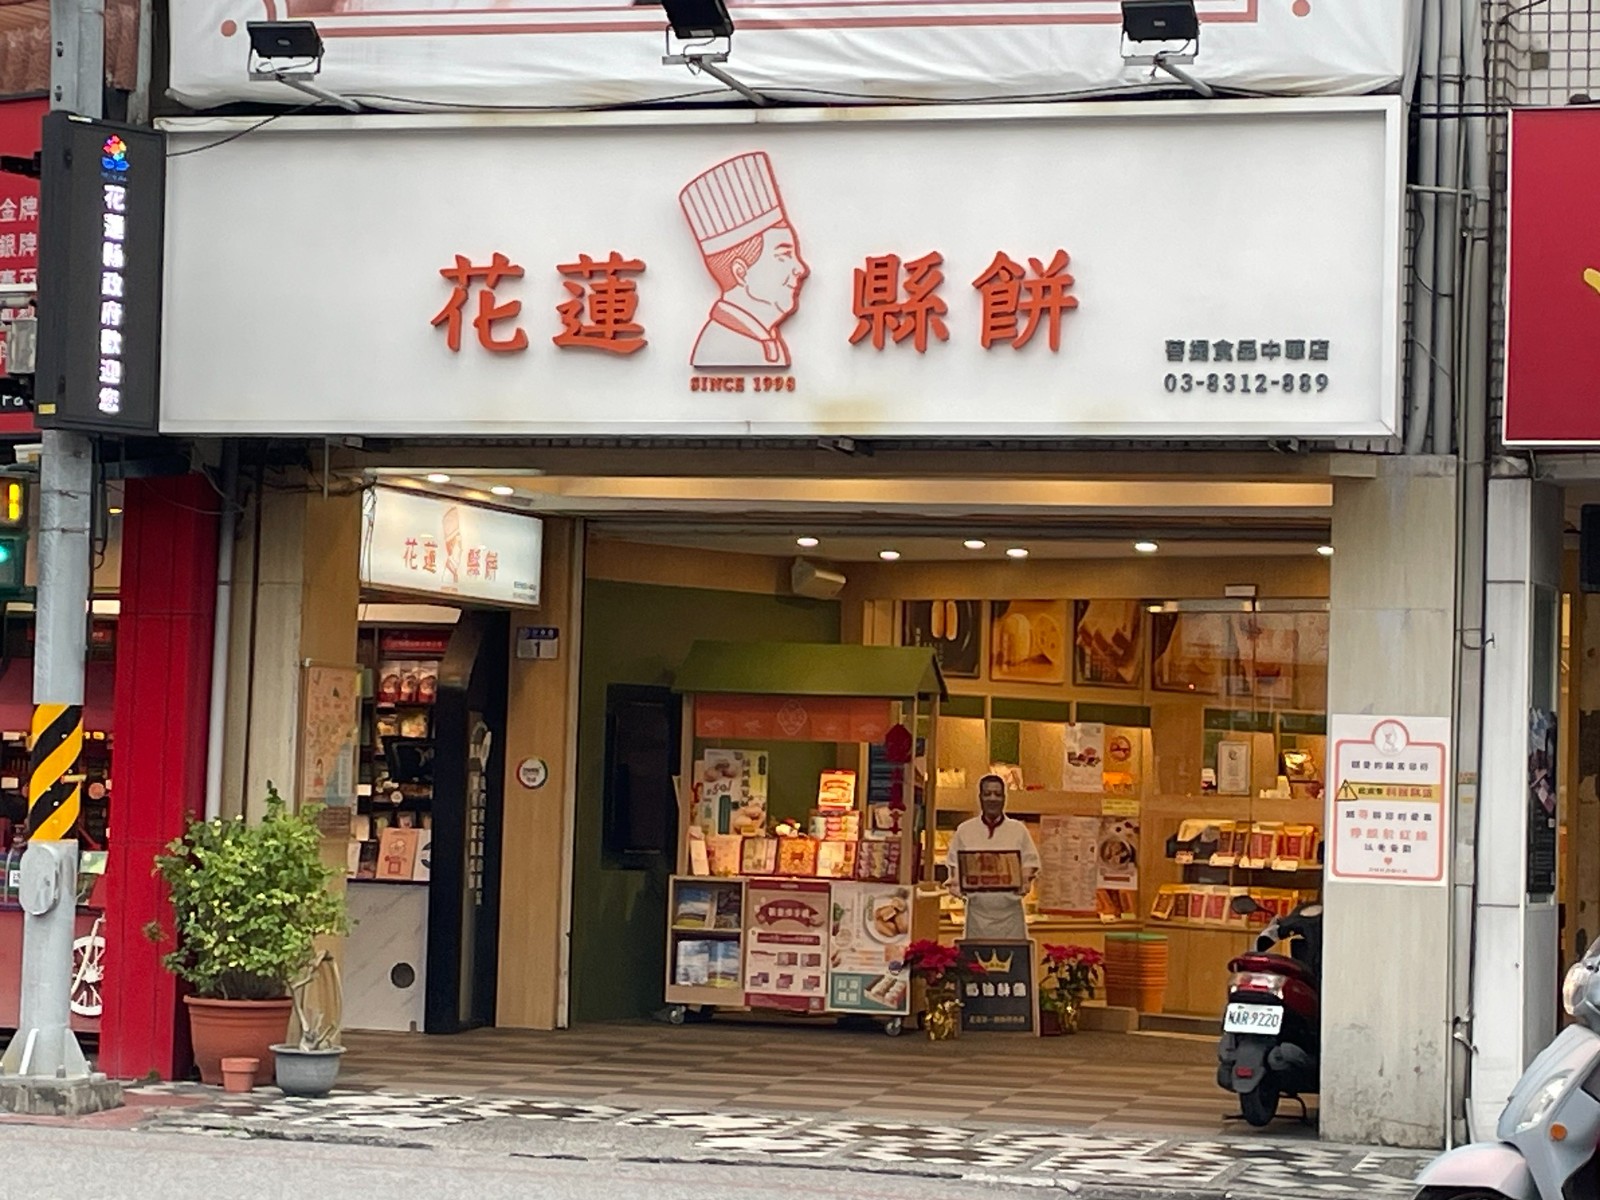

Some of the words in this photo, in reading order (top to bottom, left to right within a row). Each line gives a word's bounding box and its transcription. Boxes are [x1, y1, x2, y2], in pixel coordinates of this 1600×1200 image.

[430, 250, 648, 355] 花蓮
[848, 249, 1078, 354] 縣餅
[691, 376, 744, 391] SINCE
[1164, 373, 1329, 393] 03-8312-889
[403, 538, 438, 574] 花蓮
